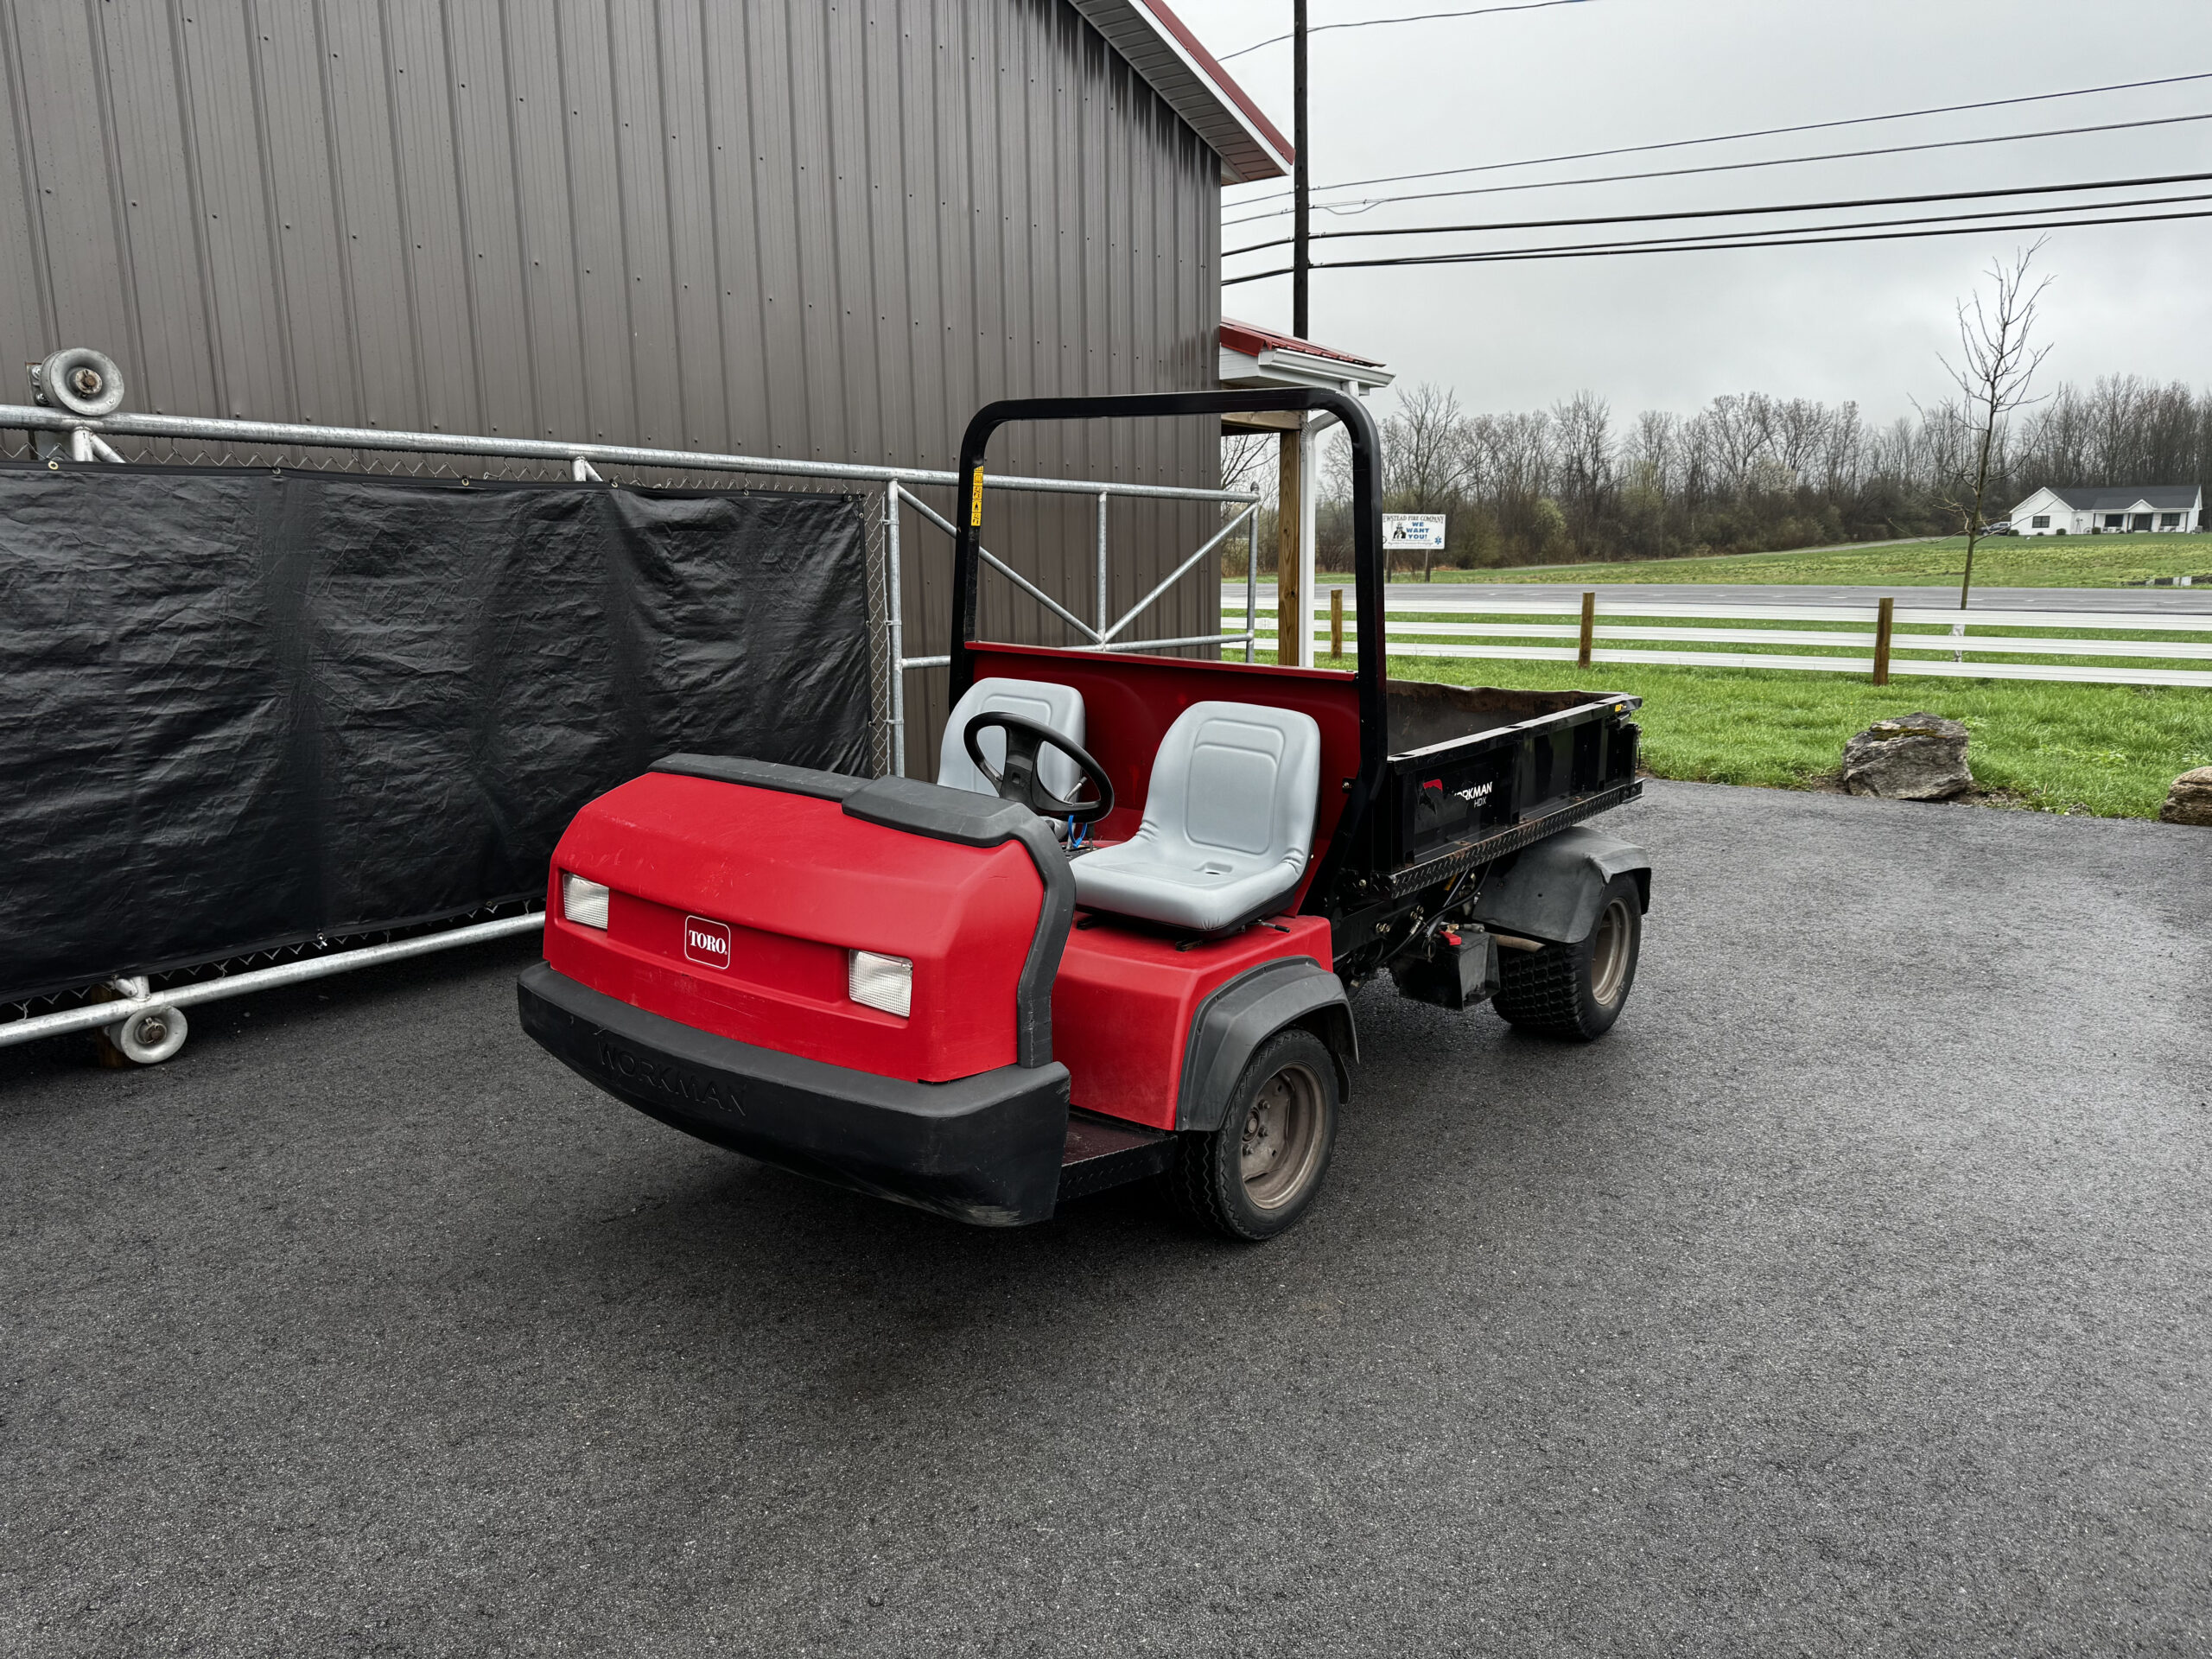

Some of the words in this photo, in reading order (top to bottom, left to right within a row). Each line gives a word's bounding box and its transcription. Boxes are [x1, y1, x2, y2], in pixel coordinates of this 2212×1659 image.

[1420, 515, 1444, 524] COMPANY
[1453, 781, 1493, 801] RKMAN
[1473, 796, 1487, 809] HDX
[689, 930, 727, 954] TORO
[597, 1039, 747, 1116] WORKMAN
